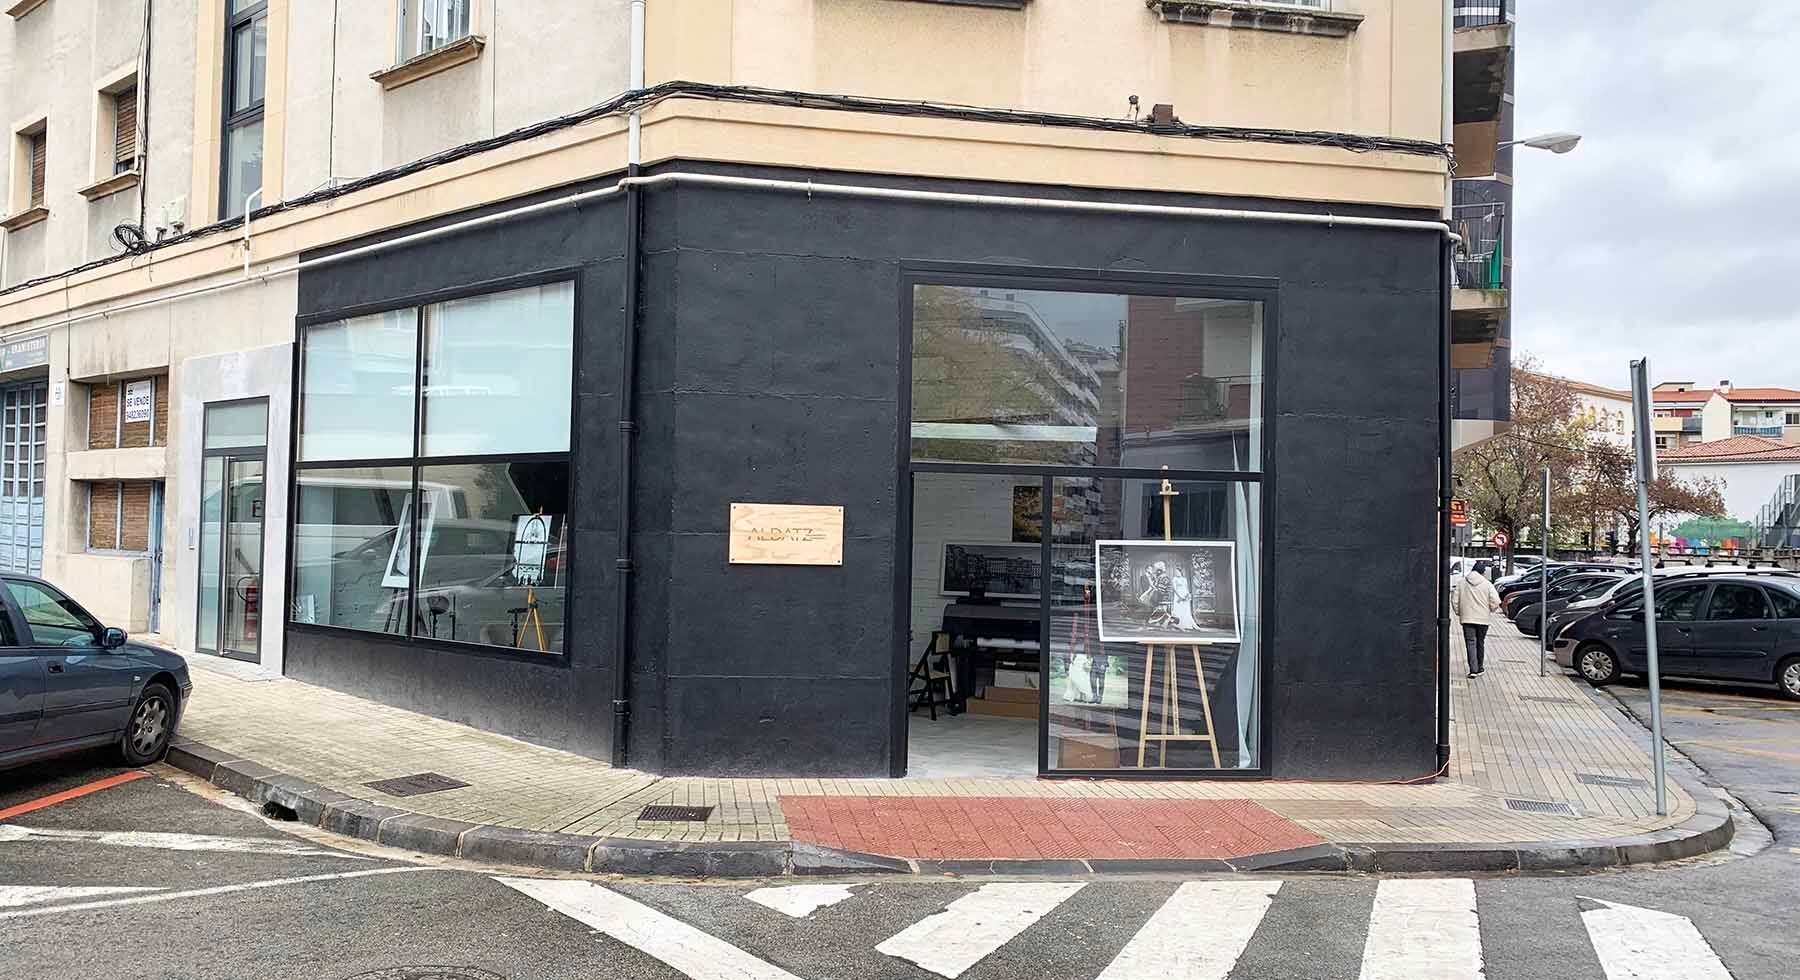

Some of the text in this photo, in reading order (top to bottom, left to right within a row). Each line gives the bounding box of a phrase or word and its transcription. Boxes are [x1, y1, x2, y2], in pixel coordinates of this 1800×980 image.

[127, 395, 149, 407] SE VENDE
[747, 527, 817, 542] ALDATZ
